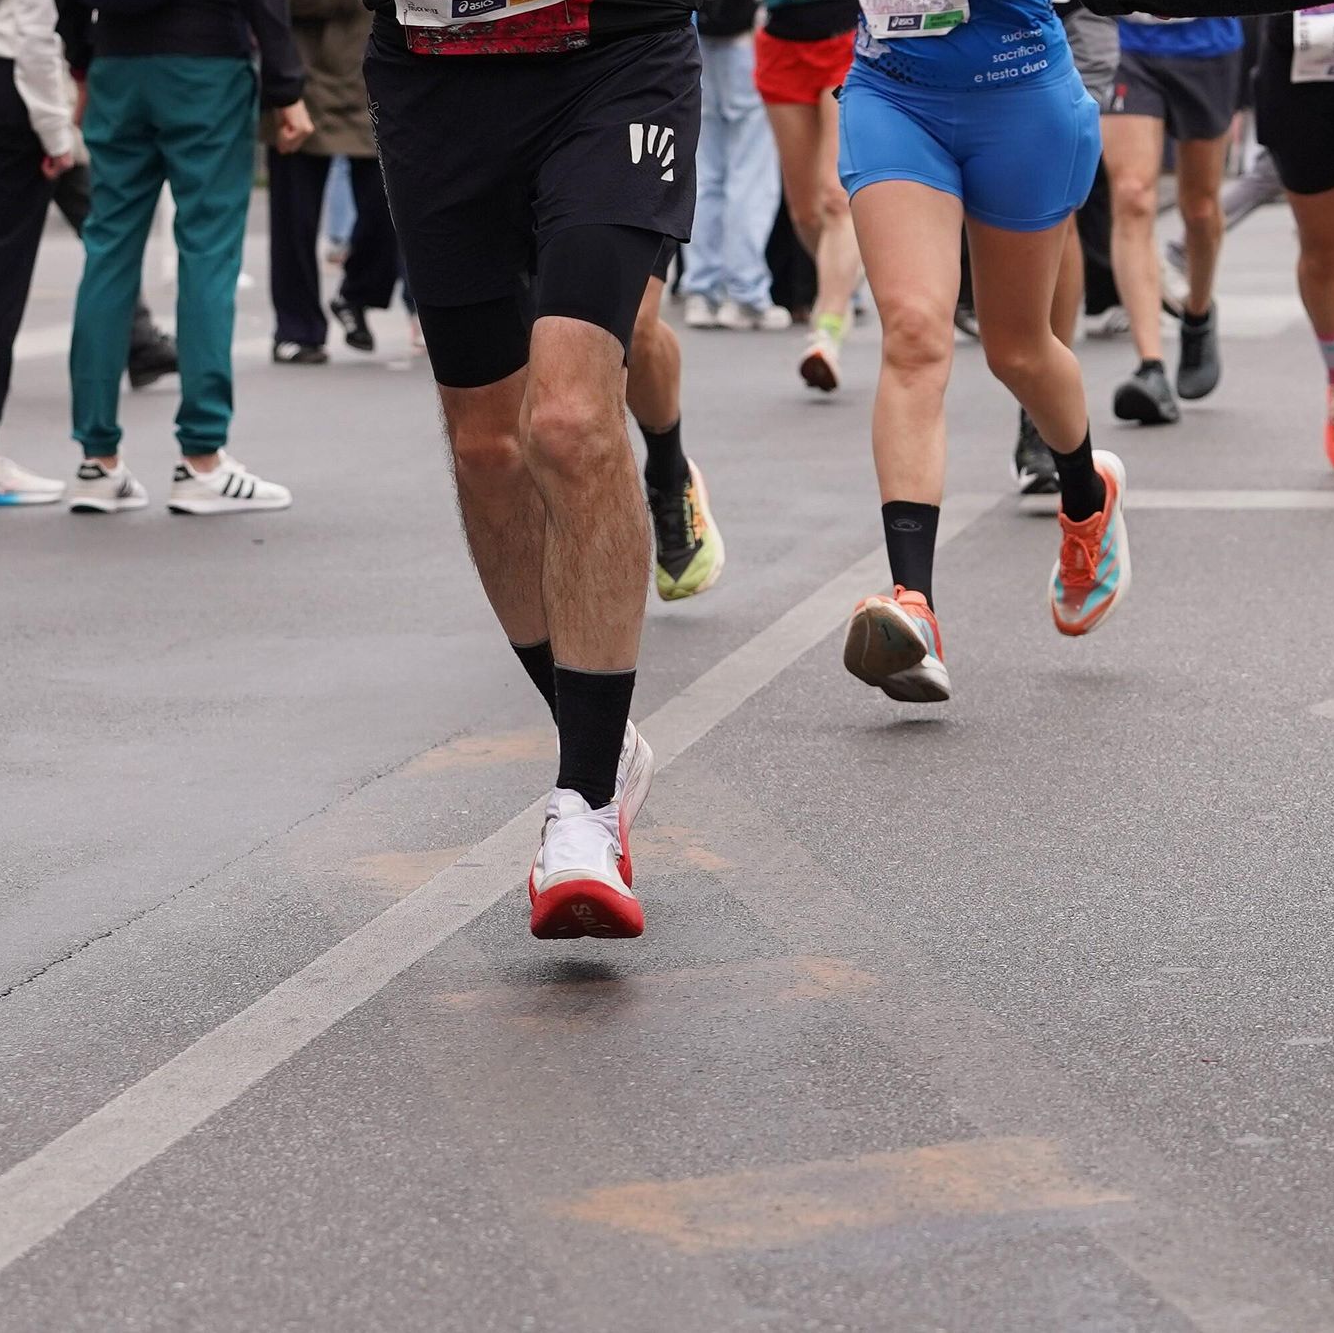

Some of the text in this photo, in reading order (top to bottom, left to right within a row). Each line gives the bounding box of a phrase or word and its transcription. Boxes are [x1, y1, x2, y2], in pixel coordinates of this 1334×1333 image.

[1001, 28, 1043, 44] sudore
[992, 43, 1046, 63] sacrificio
[974, 59, 1048, 83] e testa dura
